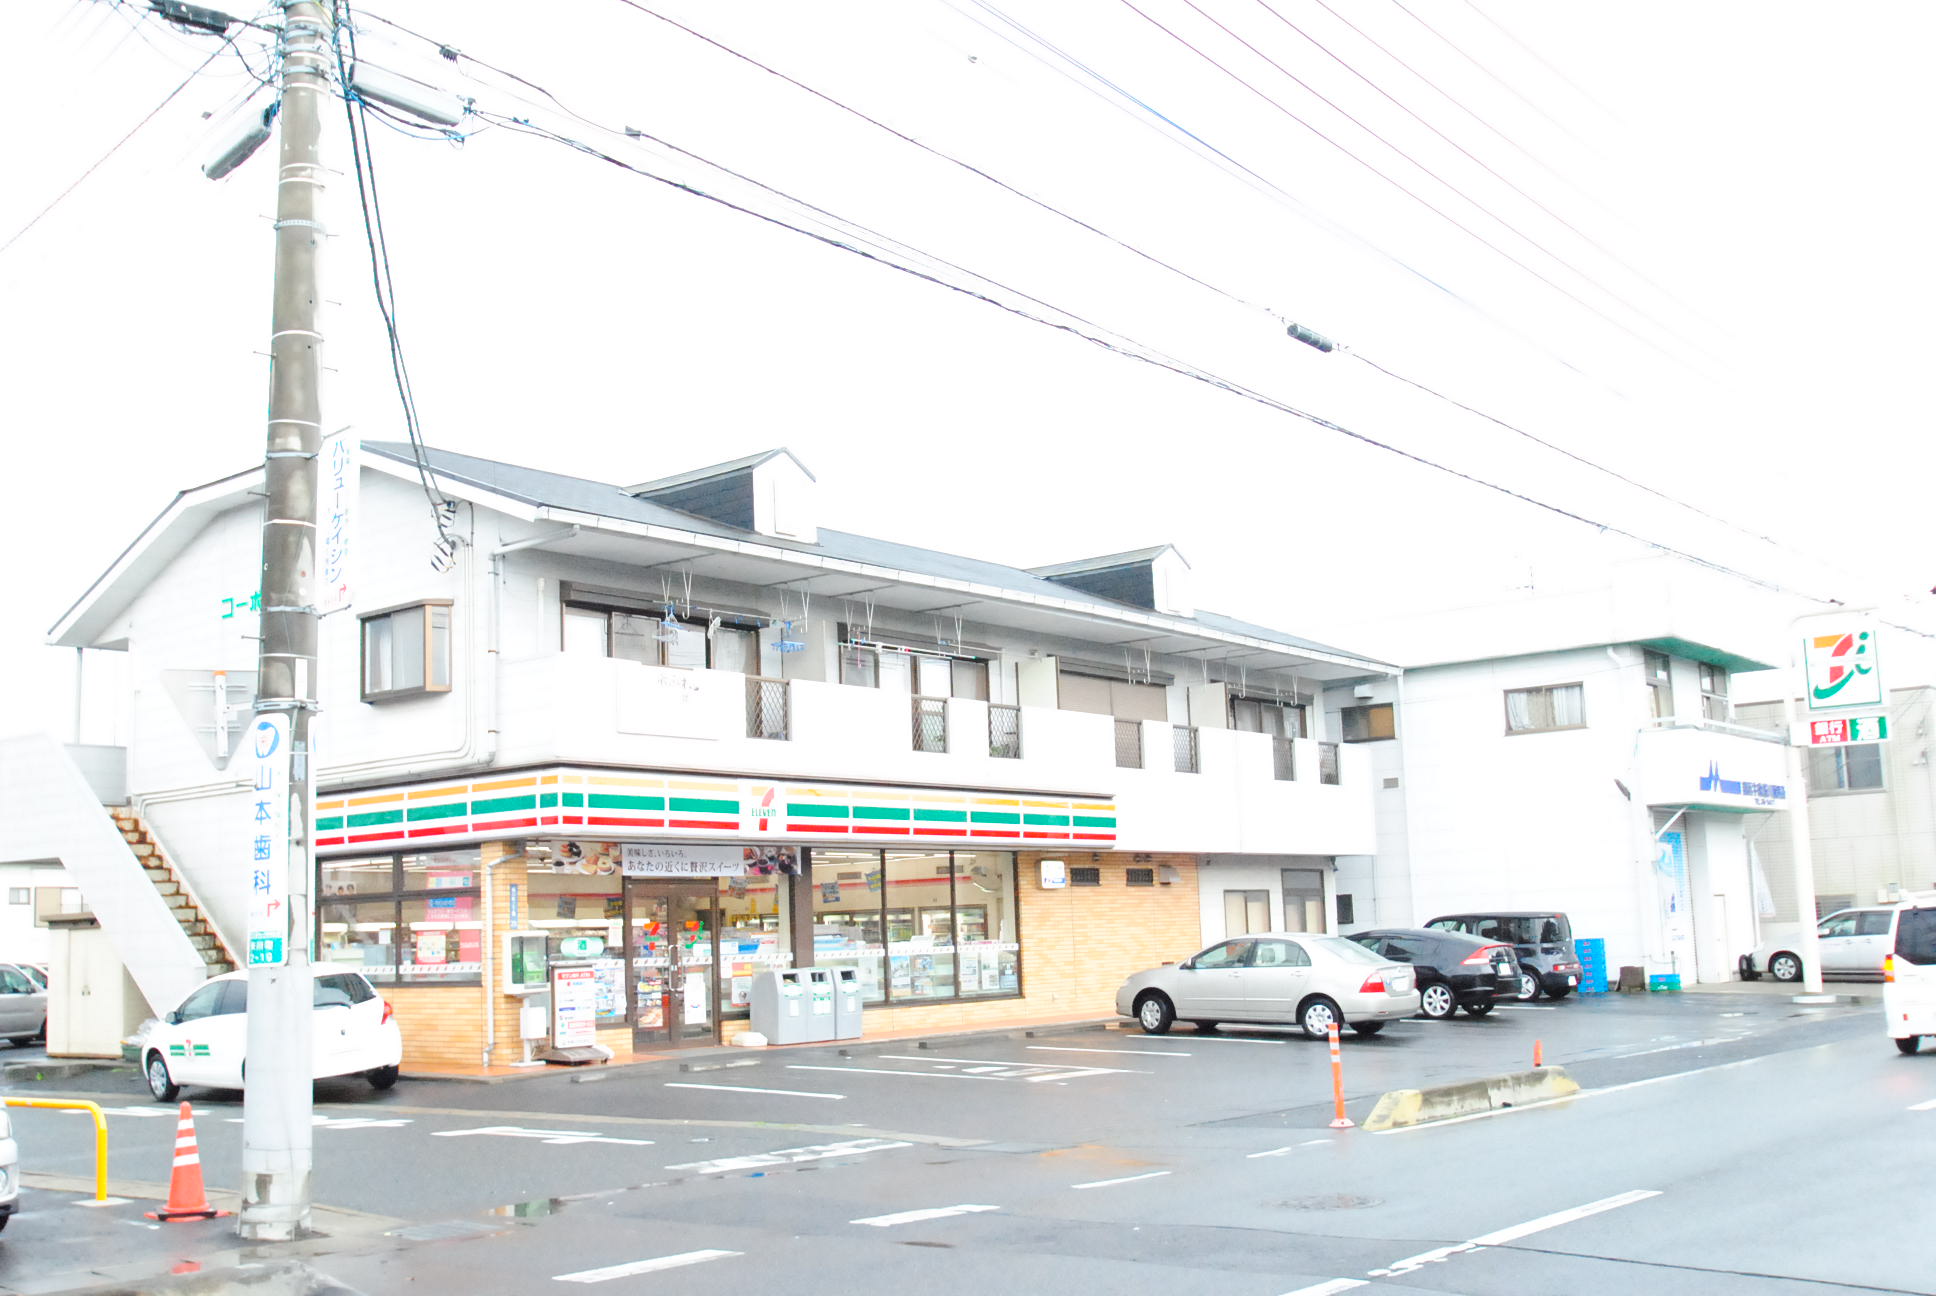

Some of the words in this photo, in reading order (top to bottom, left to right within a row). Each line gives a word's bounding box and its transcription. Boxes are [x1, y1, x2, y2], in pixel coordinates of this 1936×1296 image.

[1815, 720, 1843, 735] 銀行
[1856, 717, 1879, 740] 酒
[1820, 734, 1841, 743] ATM
[254, 764, 272, 895] 山本歯科
[627, 860, 740, 873] あなたの近くに贅沢スイーツ
